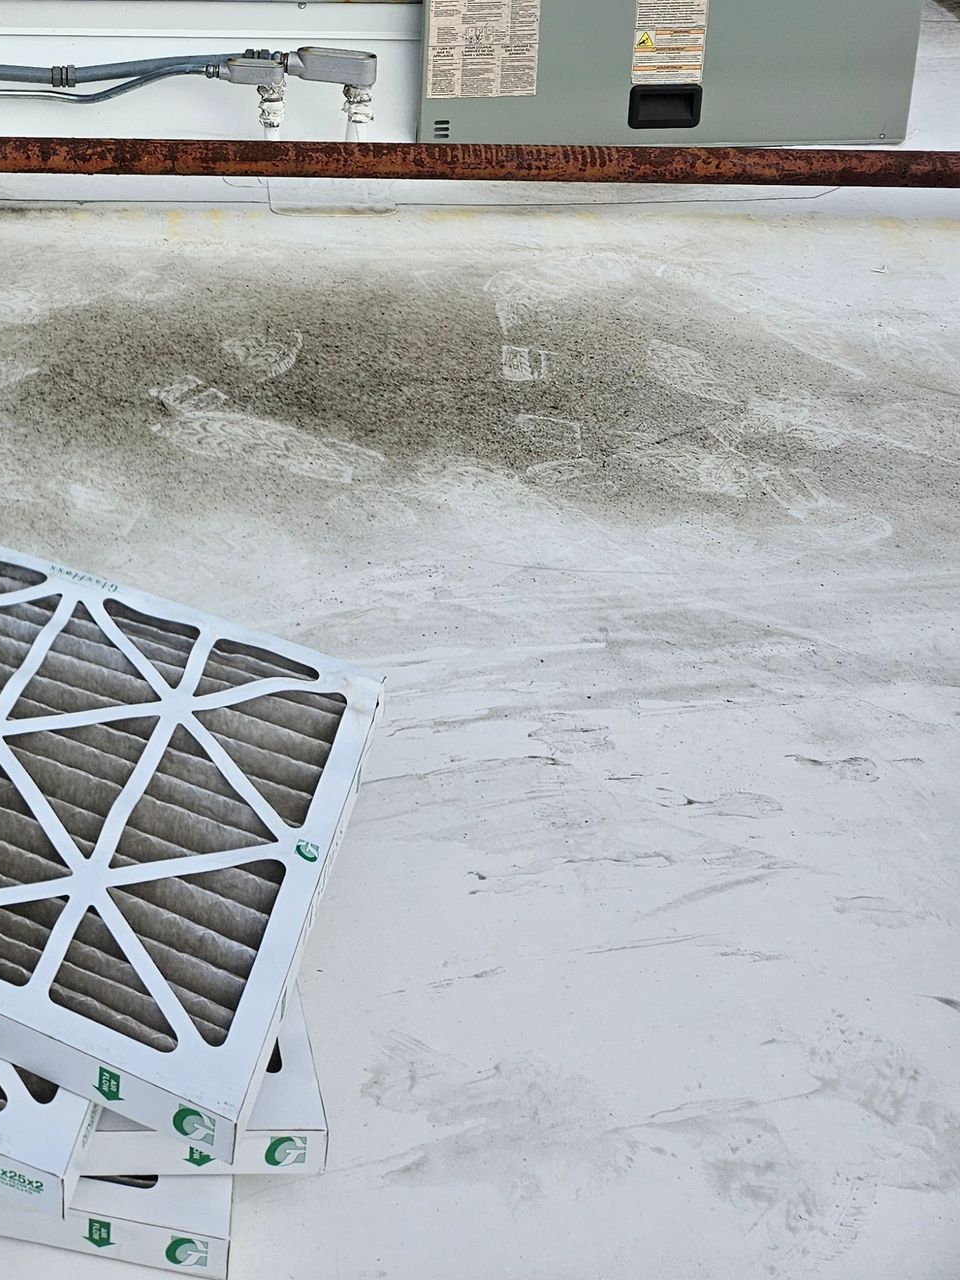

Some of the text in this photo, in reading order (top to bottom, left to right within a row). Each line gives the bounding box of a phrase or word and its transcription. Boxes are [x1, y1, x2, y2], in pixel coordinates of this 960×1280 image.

[50, 565, 118, 593] Glasfloss
[101, 1071, 111, 1093] FLOW
[109, 1078, 118, 1092] AIR
[92, 1222, 100, 1241] FLOW
[100, 1227, 108, 1239] AIR
